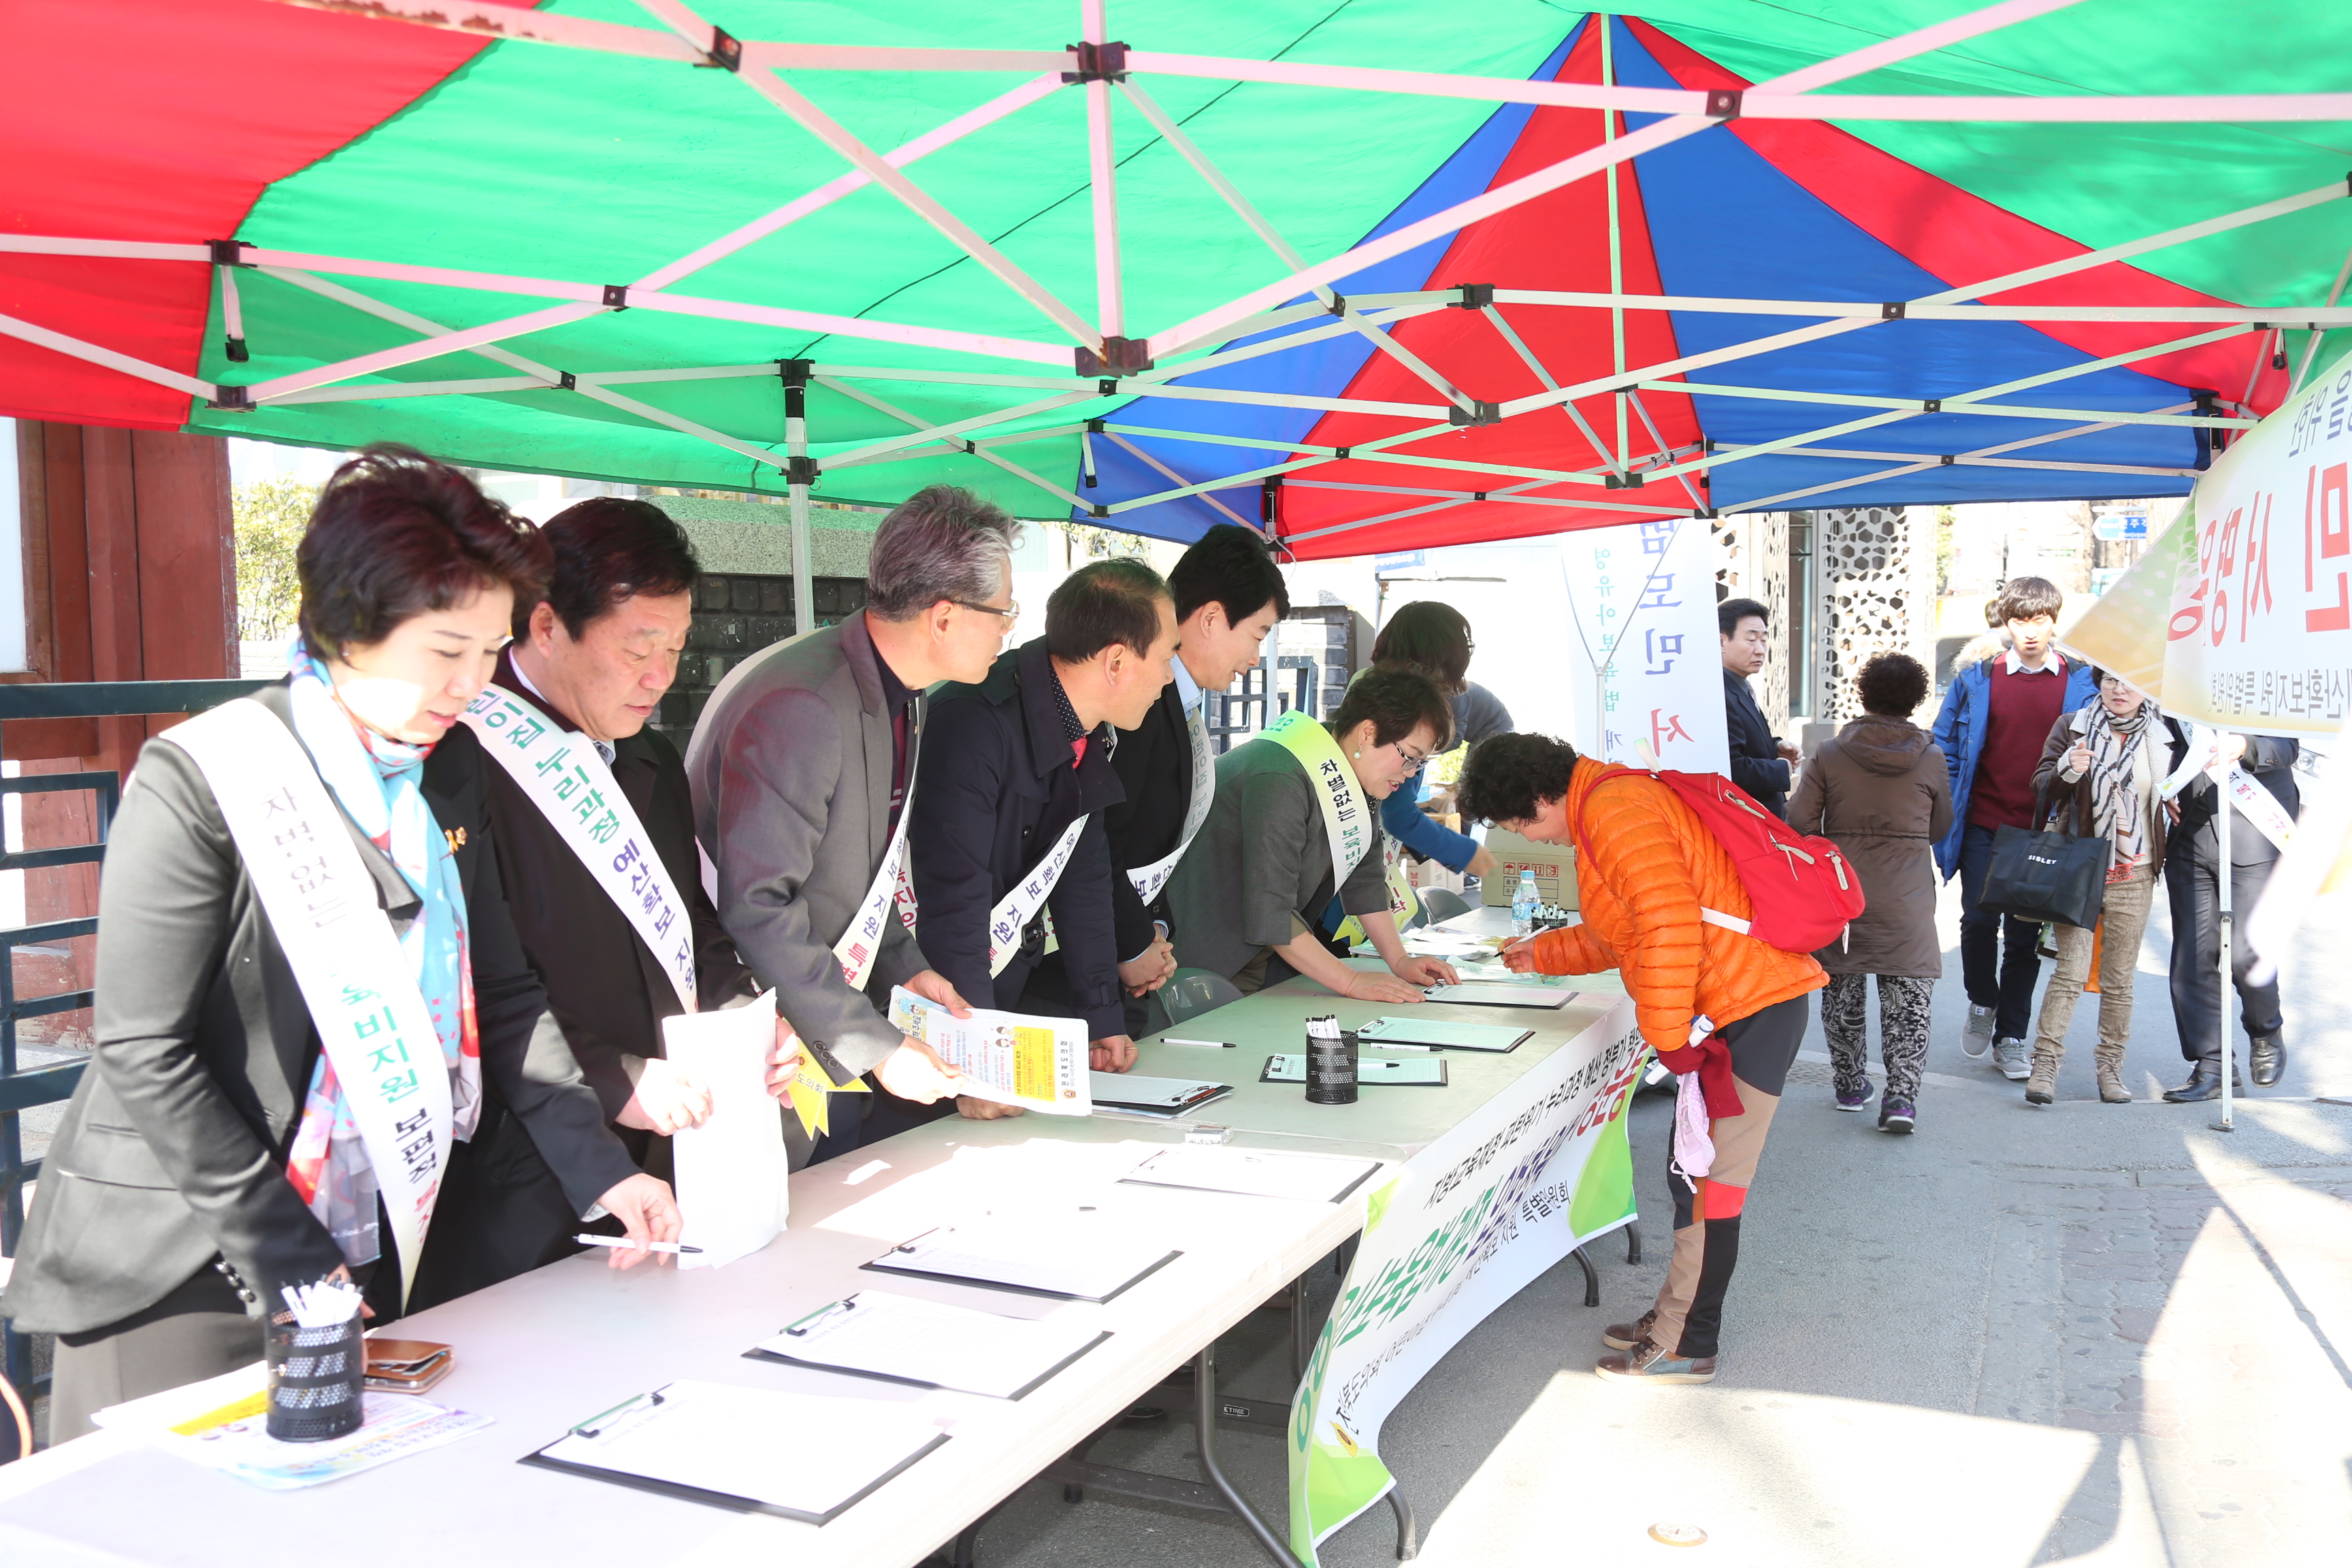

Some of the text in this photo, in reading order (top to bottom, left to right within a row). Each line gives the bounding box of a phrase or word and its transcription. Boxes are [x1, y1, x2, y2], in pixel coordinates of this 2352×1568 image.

[1320, 758, 1357, 823] 차별없는
[535, 747, 621, 845] 누리과정
[612, 838, 676, 941] 예산확보
[674, 936, 696, 992] 지원
[992, 832, 1076, 946] 예산확보 지원
[2027, 855, 2057, 866] SISLEY
[862, 894, 887, 941] 지원
[259, 785, 348, 929] 차별없는
[331, 971, 421, 1105] 육비지원
[395, 1107, 438, 1185] 보편적
[912, 1015, 922, 1031] 주세요
[796, 1073, 824, 1095] 도의회
[1423, 1126, 1506, 1211] 지방교육재정
[1500, 1093, 1548, 1149] 파탄위기
[1544, 1064, 1586, 1120] 누리과정
[1583, 1051, 1603, 1090] 예산
[1601, 1034, 1628, 1078] 정부가
[1500, 1211, 1519, 1245] 지원
[1522, 1179, 1571, 1223] 특별위원회
[1224, 1406, 1245, 1415] ETIME
